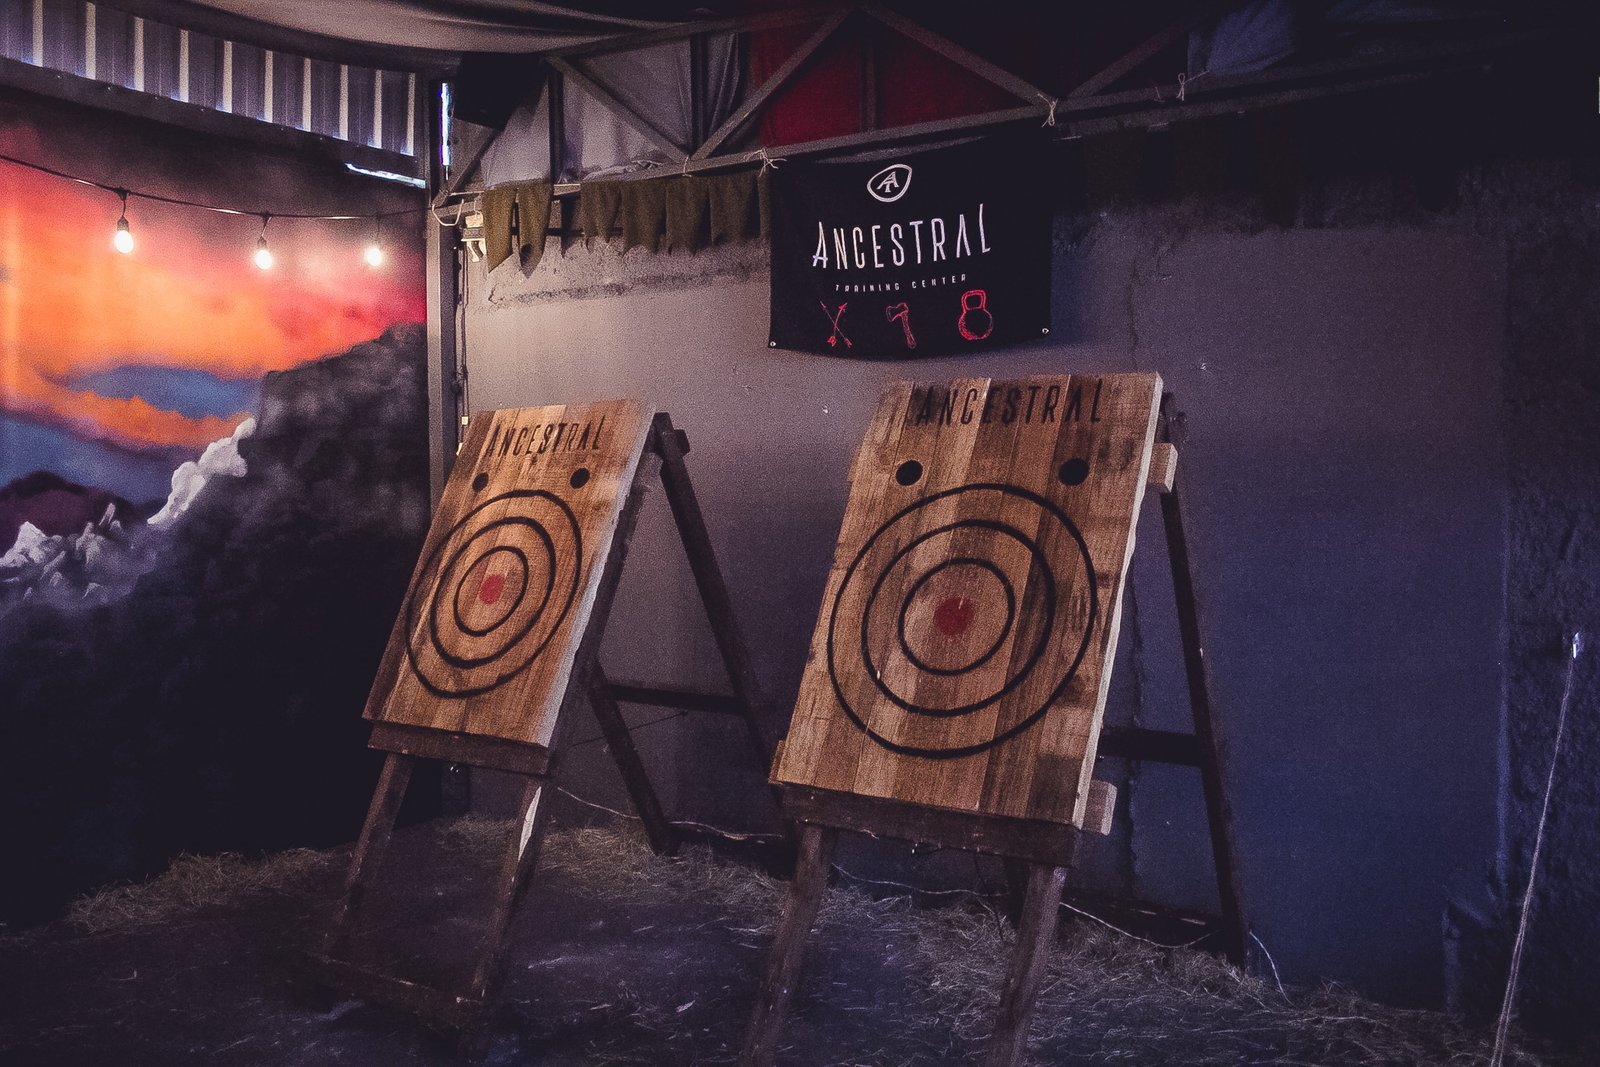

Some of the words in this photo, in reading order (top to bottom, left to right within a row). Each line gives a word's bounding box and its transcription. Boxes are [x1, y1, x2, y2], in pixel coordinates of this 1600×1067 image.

[812, 202, 992, 270] ANCESTRAL
[835, 282, 901, 293] TRAINING
[911, 273, 967, 290] CENTER
[915, 378, 1103, 426] ANCESTRAL
[484, 415, 606, 458] ANCESTRAL
